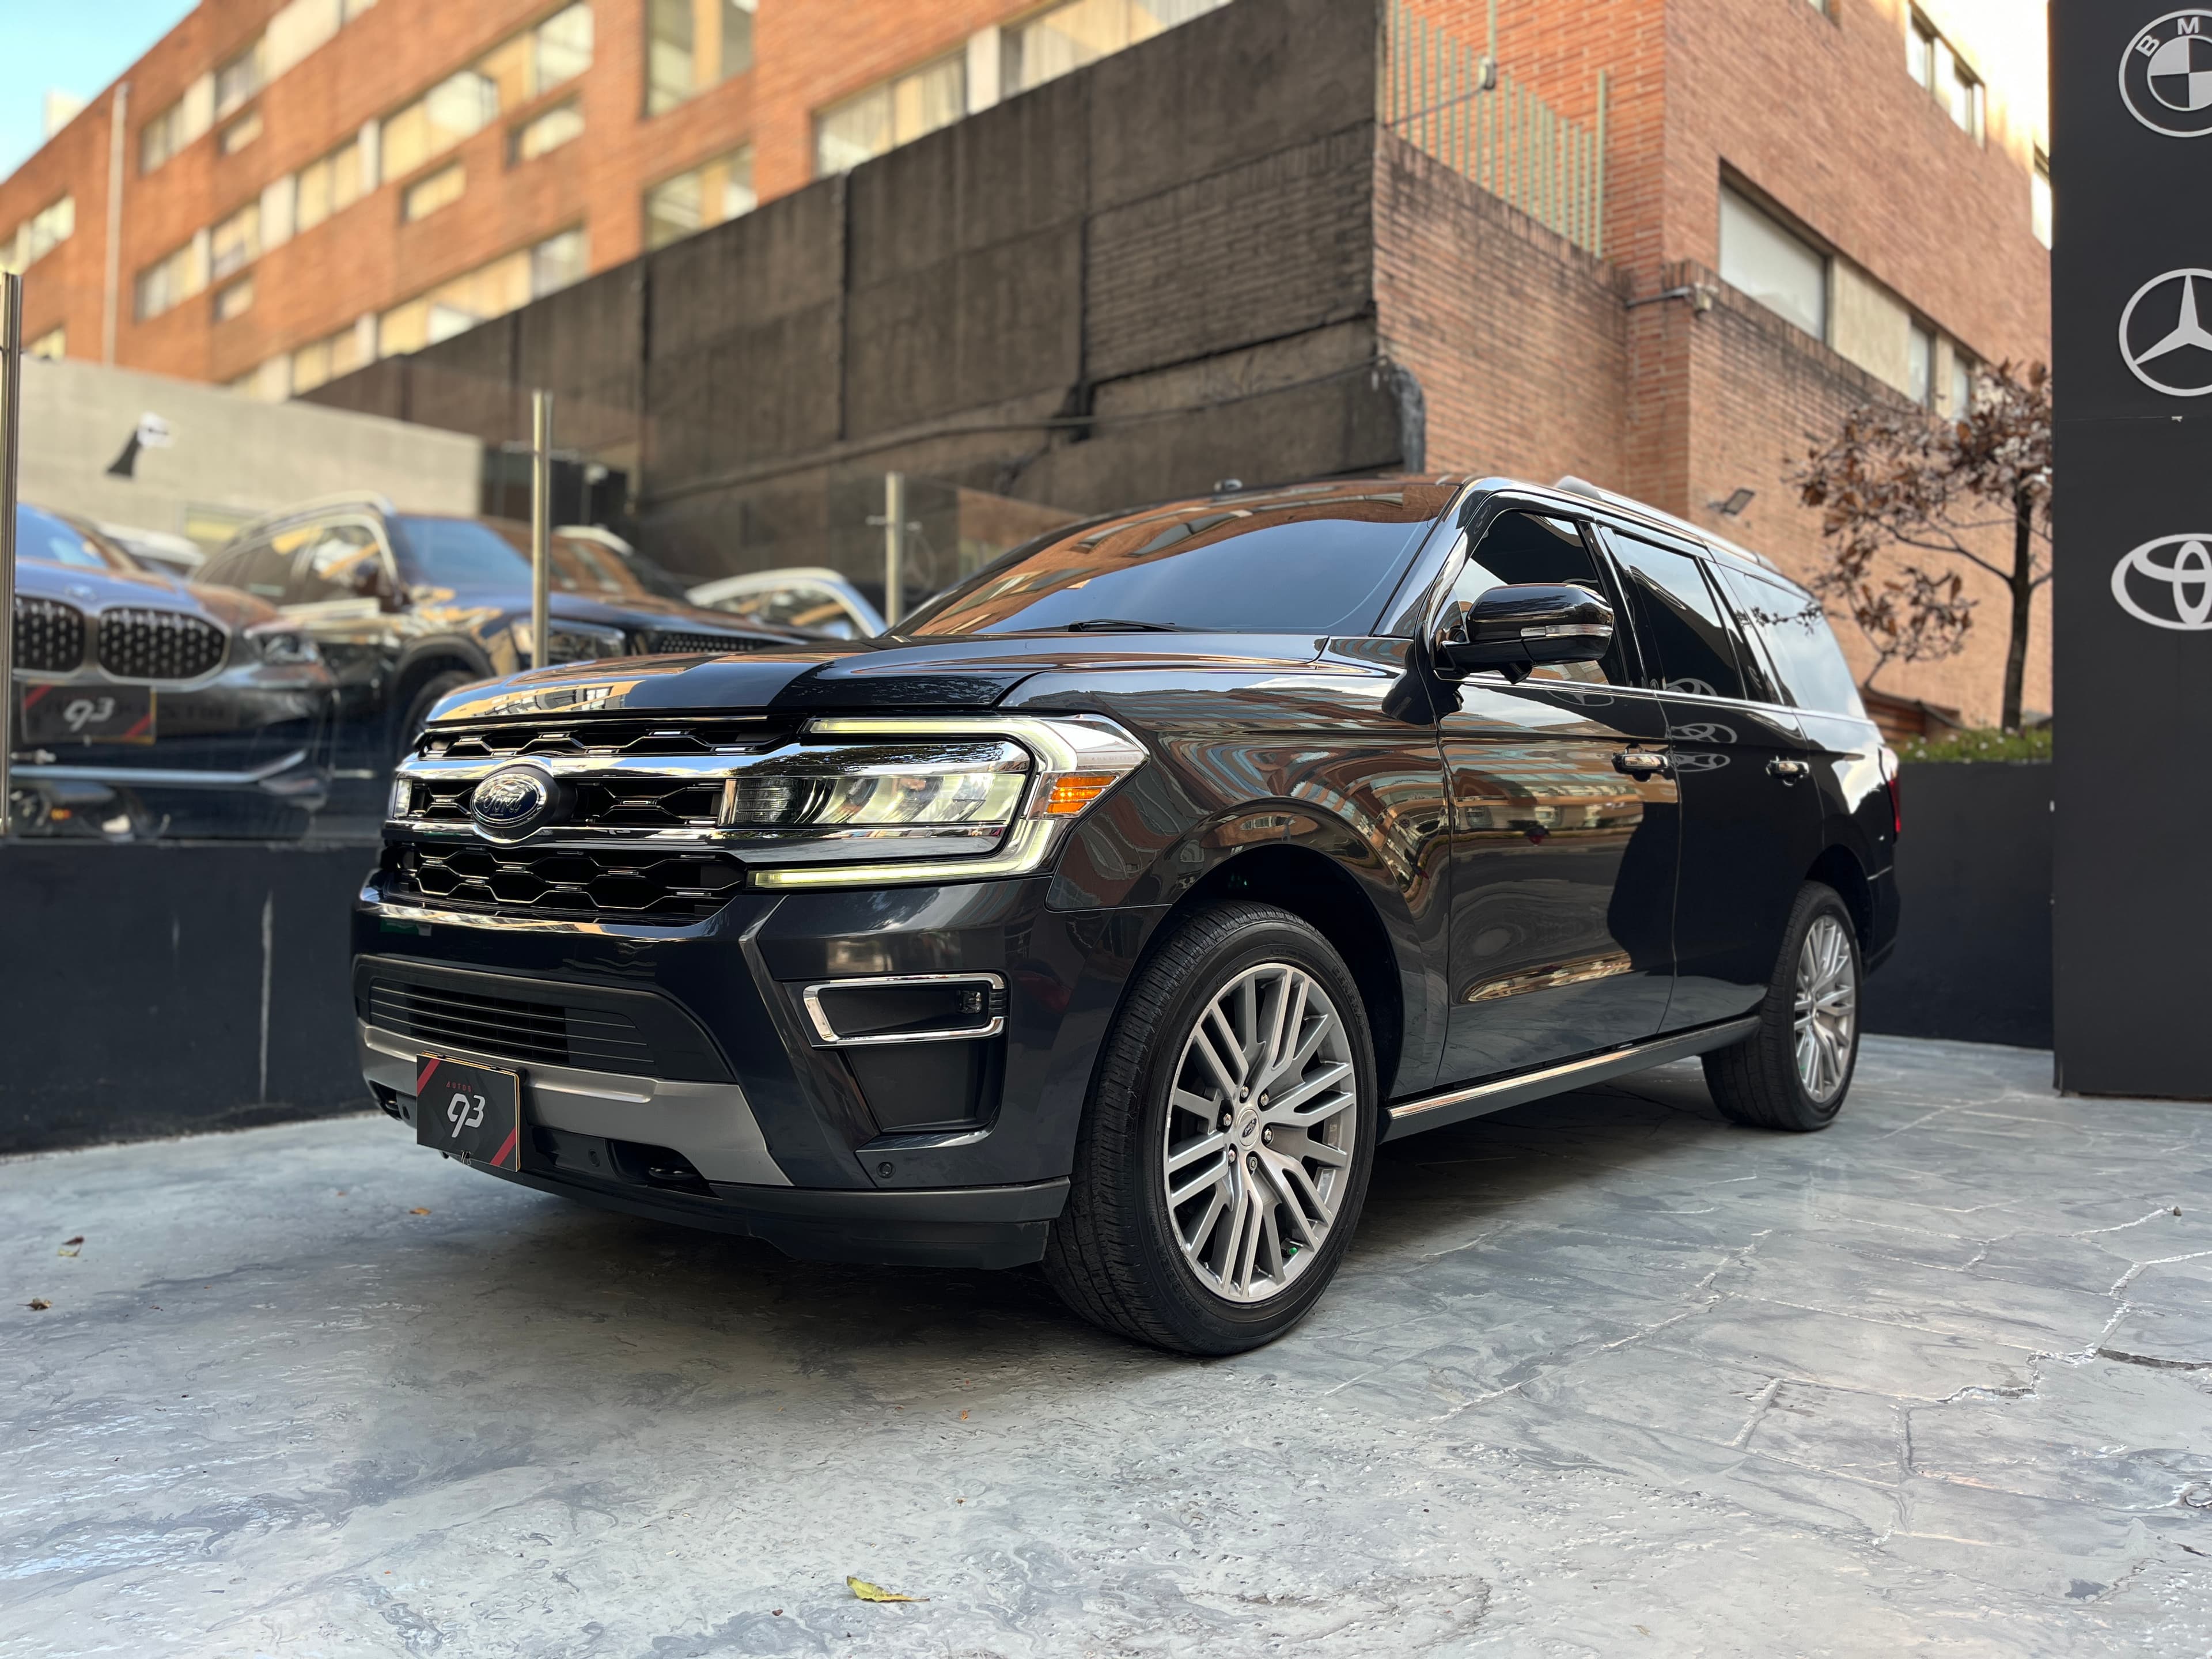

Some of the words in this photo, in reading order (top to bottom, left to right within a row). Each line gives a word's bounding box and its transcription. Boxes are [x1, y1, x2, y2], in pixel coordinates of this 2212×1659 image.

[2135, 17, 2199, 57] BM
[63, 697, 115, 732] 93
[484, 785, 524, 813] Ford
[446, 1081, 472, 1092] AUTOS
[447, 1093, 486, 1138] 93
